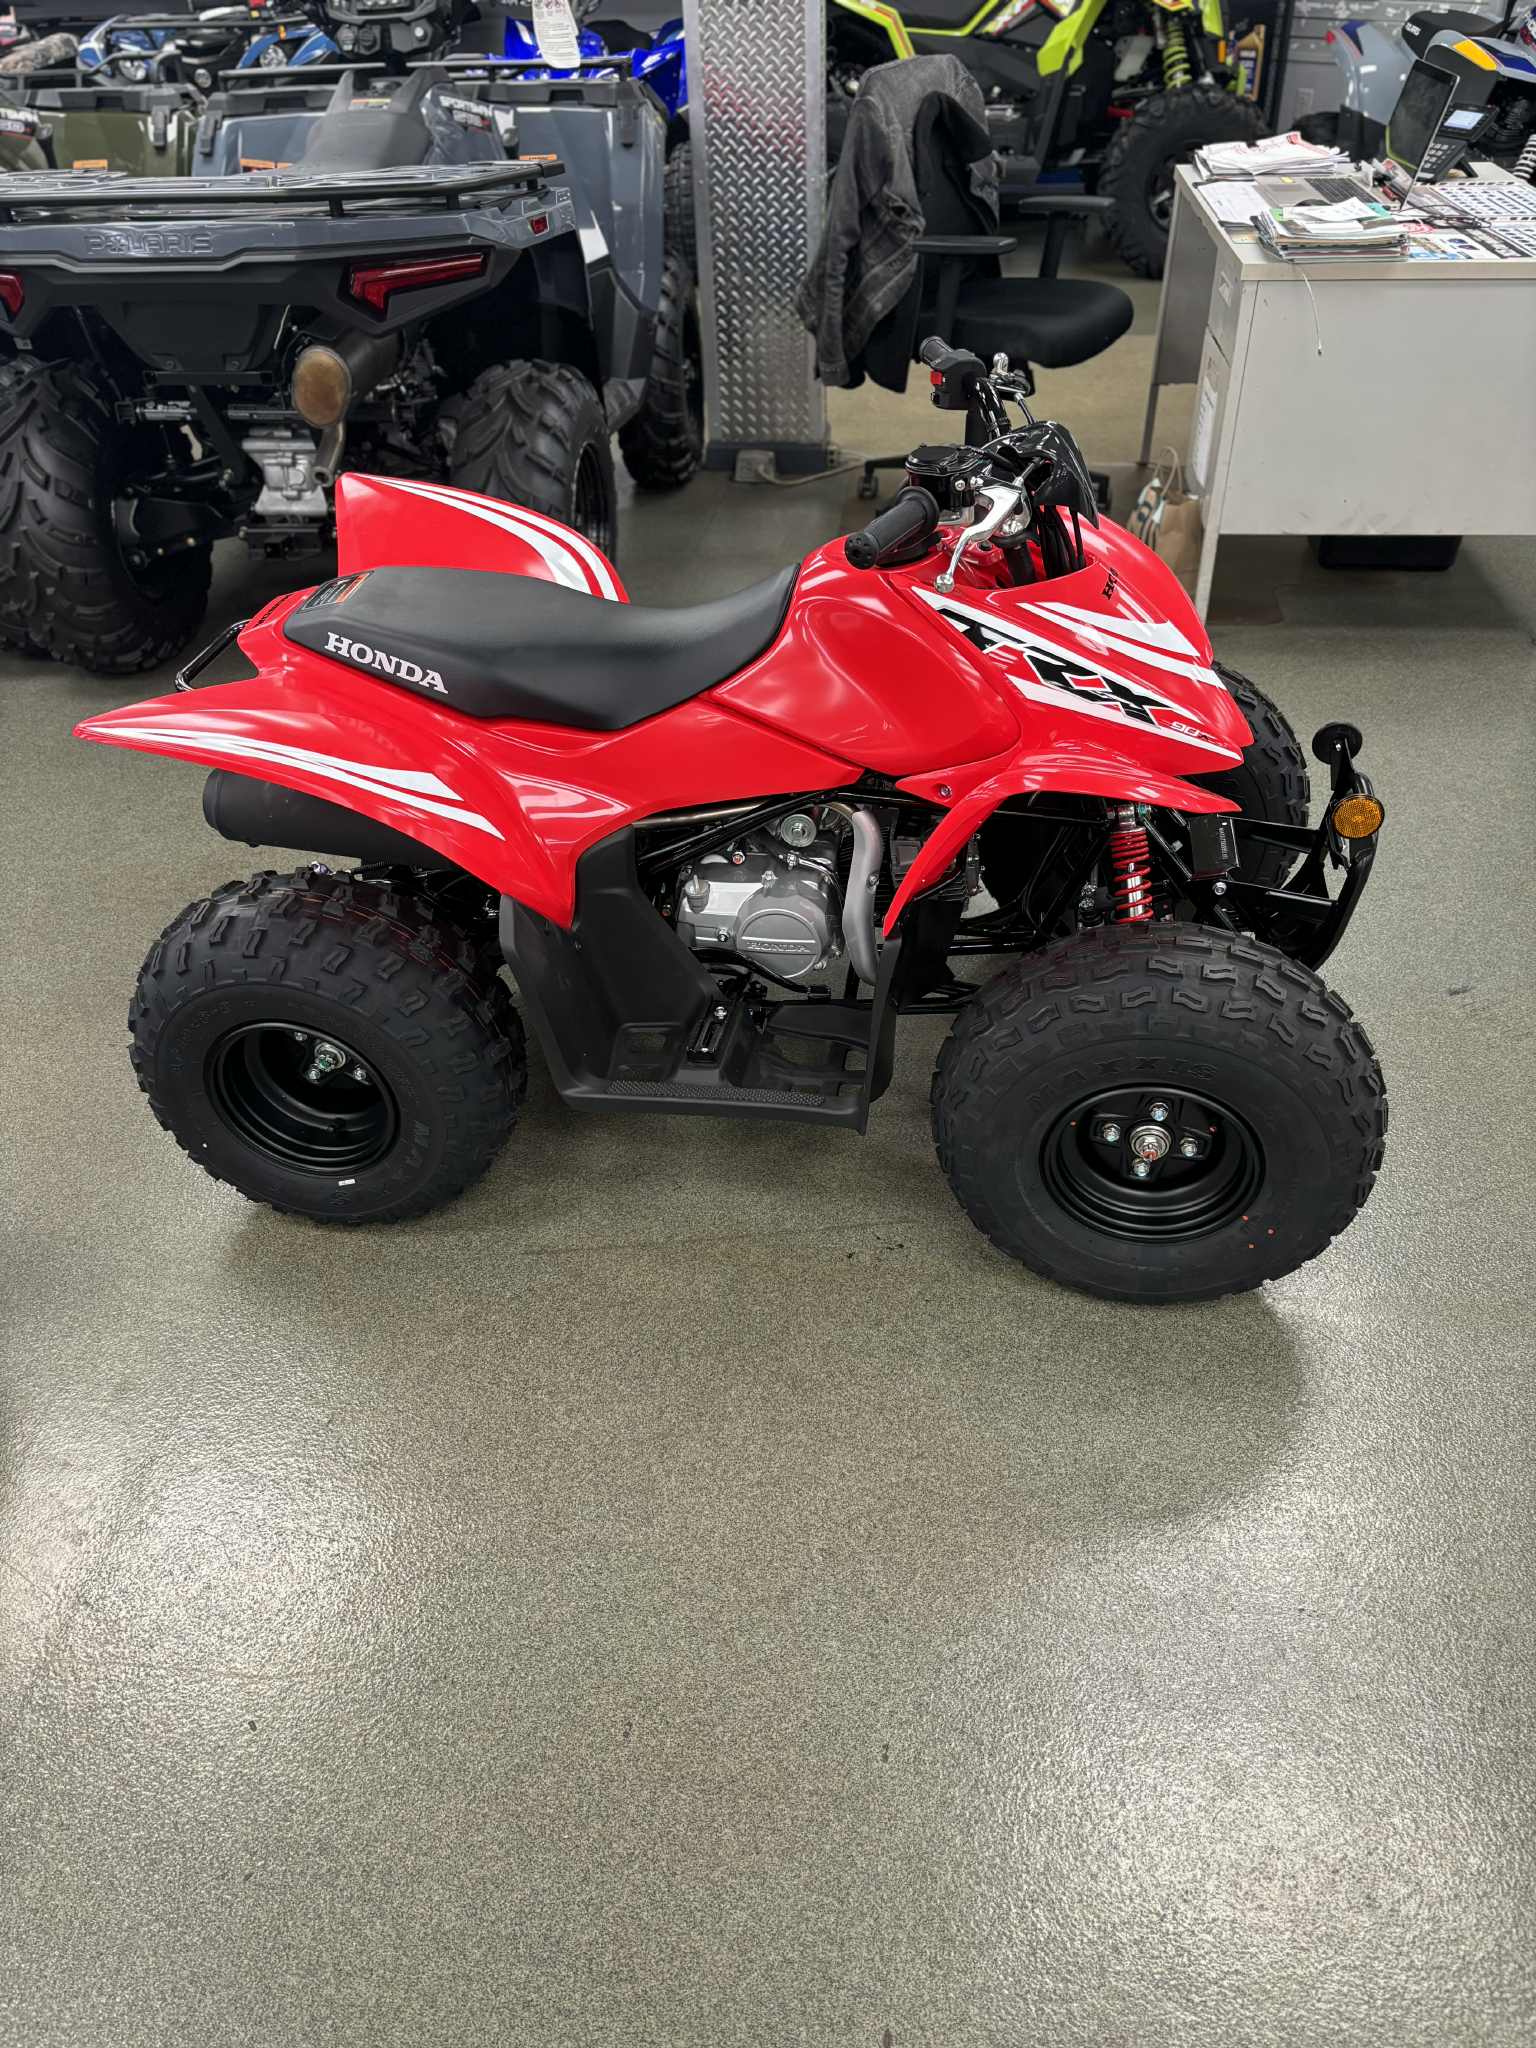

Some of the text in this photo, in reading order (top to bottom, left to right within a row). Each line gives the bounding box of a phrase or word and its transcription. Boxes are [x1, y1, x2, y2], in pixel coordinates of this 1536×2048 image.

[82, 233, 214, 256] POLARIS
[324, 632, 449, 695] HONDA
[937, 607, 1172, 728] TRX
[746, 941, 811, 954] HONDA
